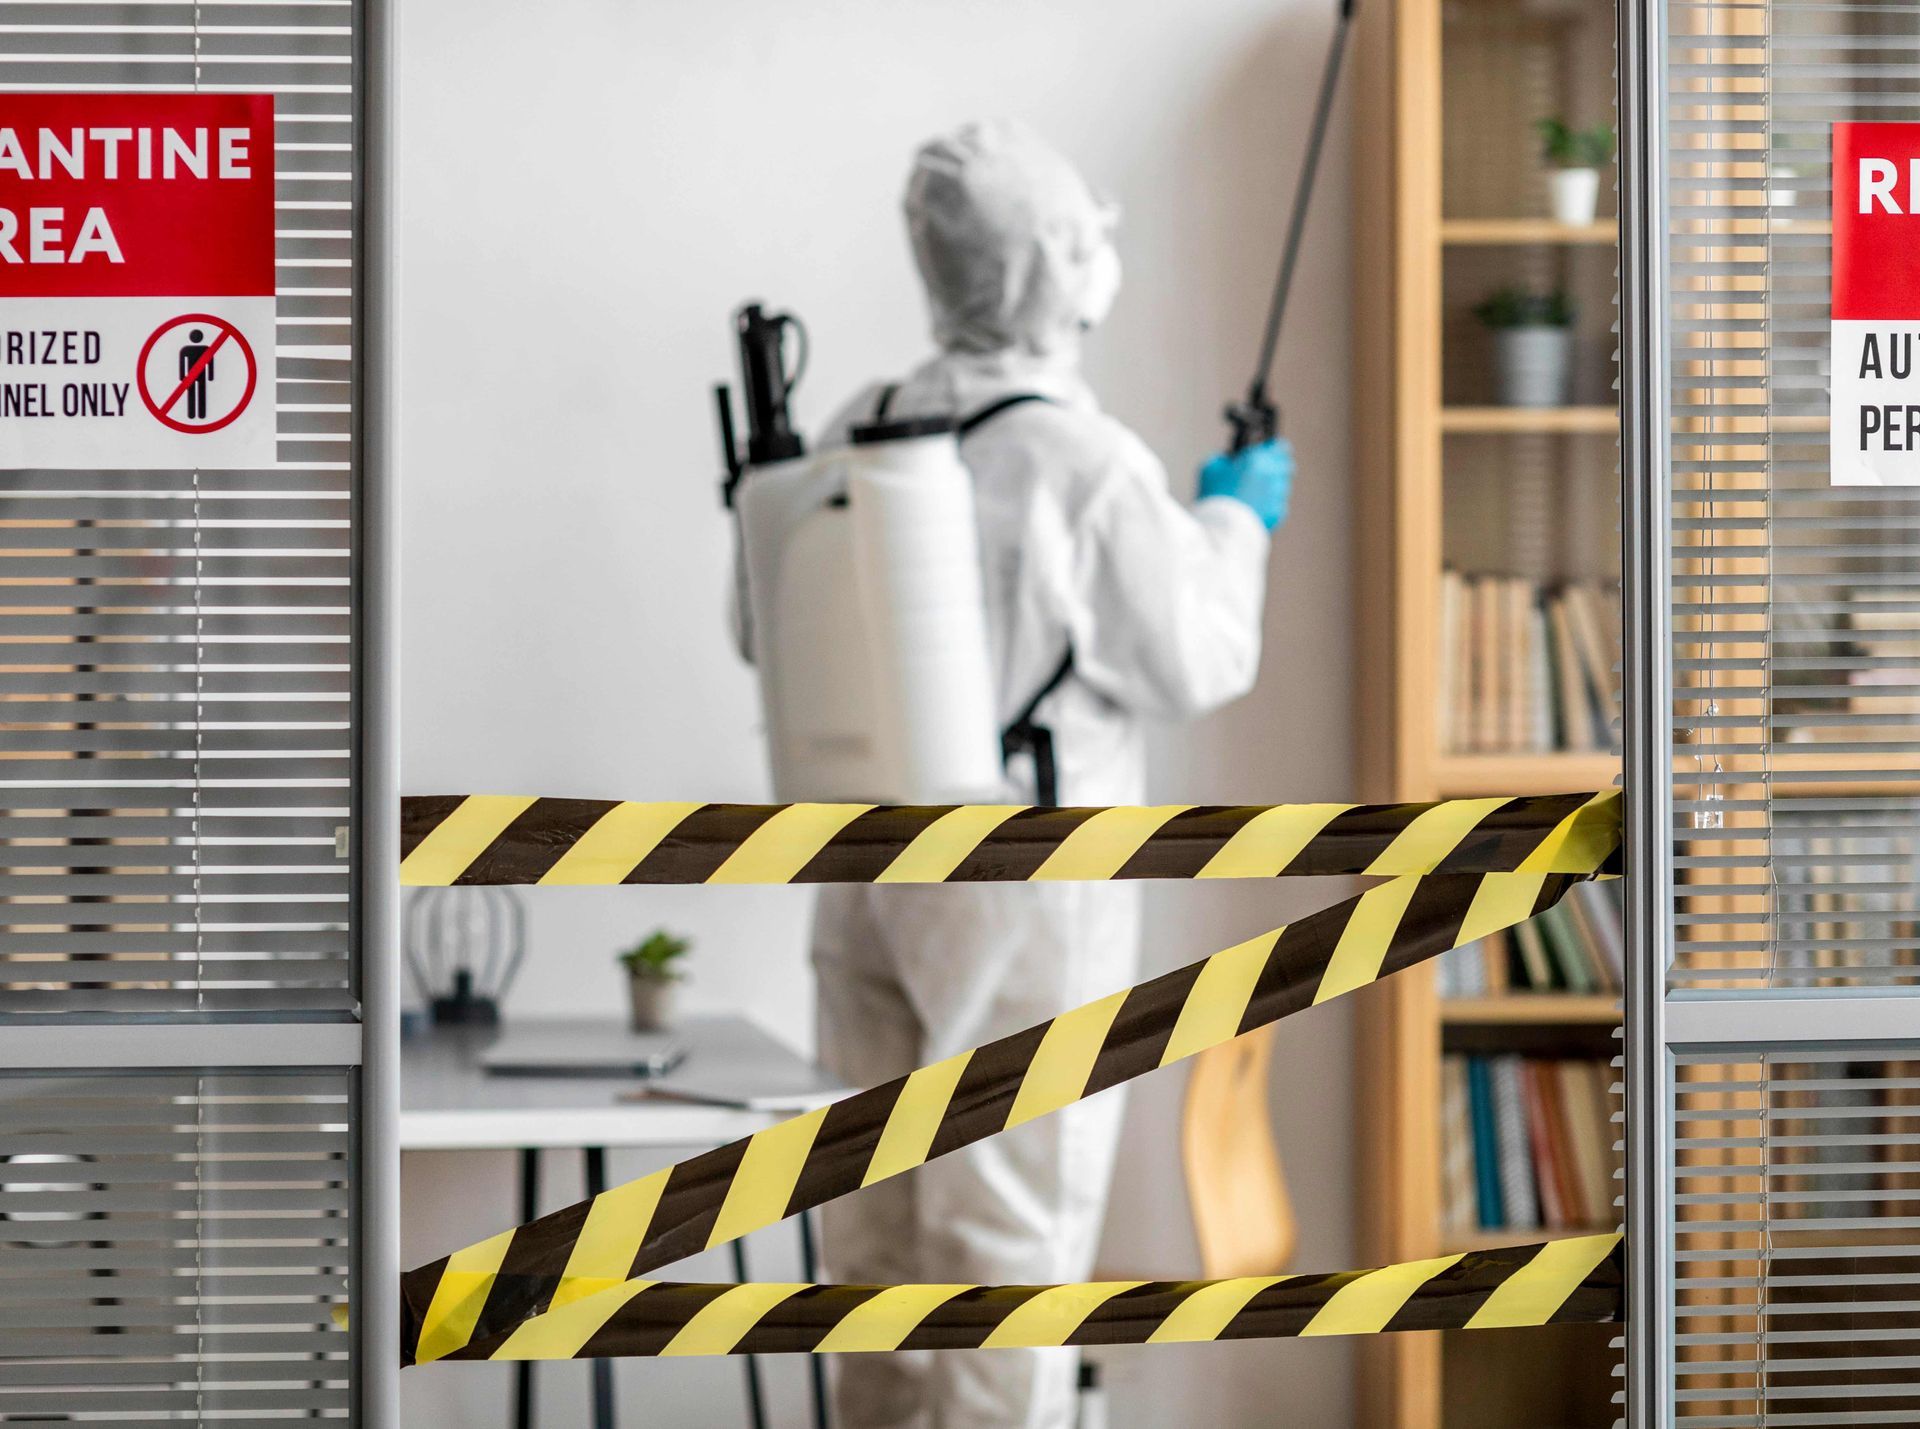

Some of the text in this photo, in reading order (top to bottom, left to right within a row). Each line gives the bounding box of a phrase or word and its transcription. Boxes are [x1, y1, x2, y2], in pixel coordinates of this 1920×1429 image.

[0, 127, 251, 180] ANTINE
[0, 330, 101, 365] RIZED
[1859, 333, 1920, 380] AU
[0, 383, 130, 417] NEL ONLY
[1860, 405, 1920, 451] PER
